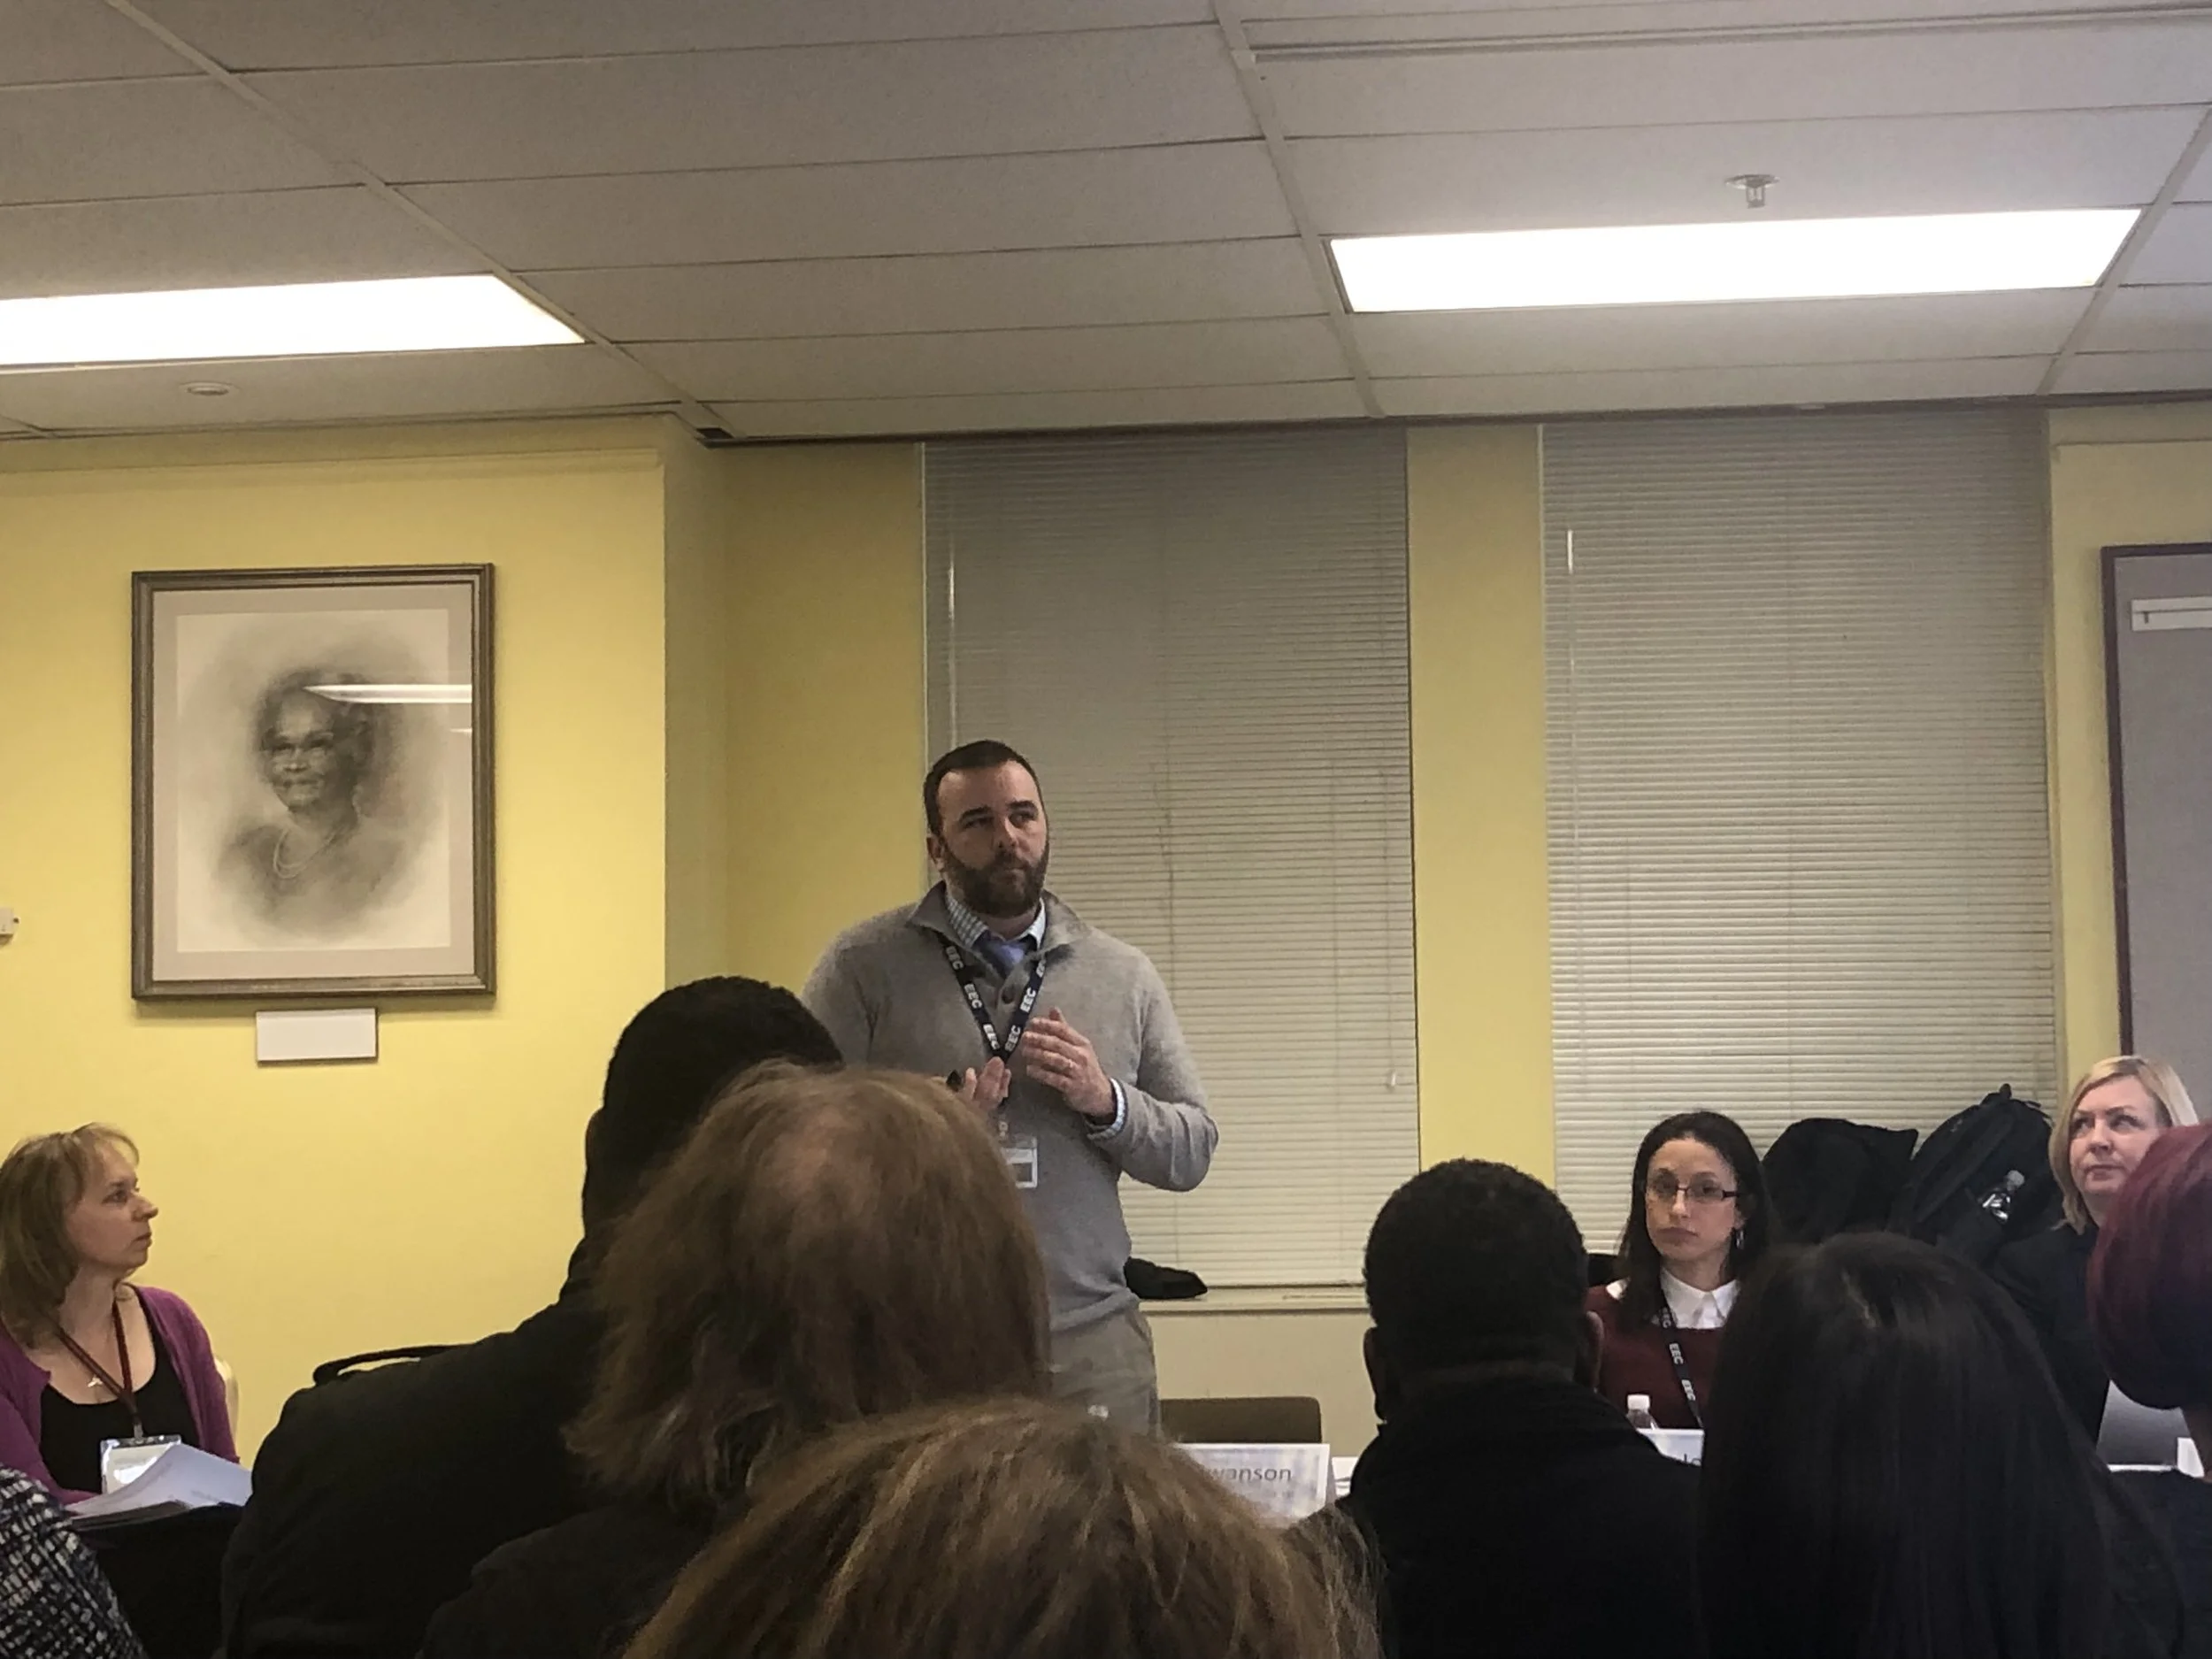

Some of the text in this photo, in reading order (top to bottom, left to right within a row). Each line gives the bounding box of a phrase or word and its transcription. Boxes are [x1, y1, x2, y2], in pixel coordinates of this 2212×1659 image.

[964, 983, 983, 1009] EEC
[1019, 987, 1036, 1013] EEC
[983, 1024, 1000, 1050] EEC
[1004, 1025, 1021, 1052] EEC
[1669, 1343, 1684, 1364] EEC
[1209, 1467, 1292, 1483] wanson
